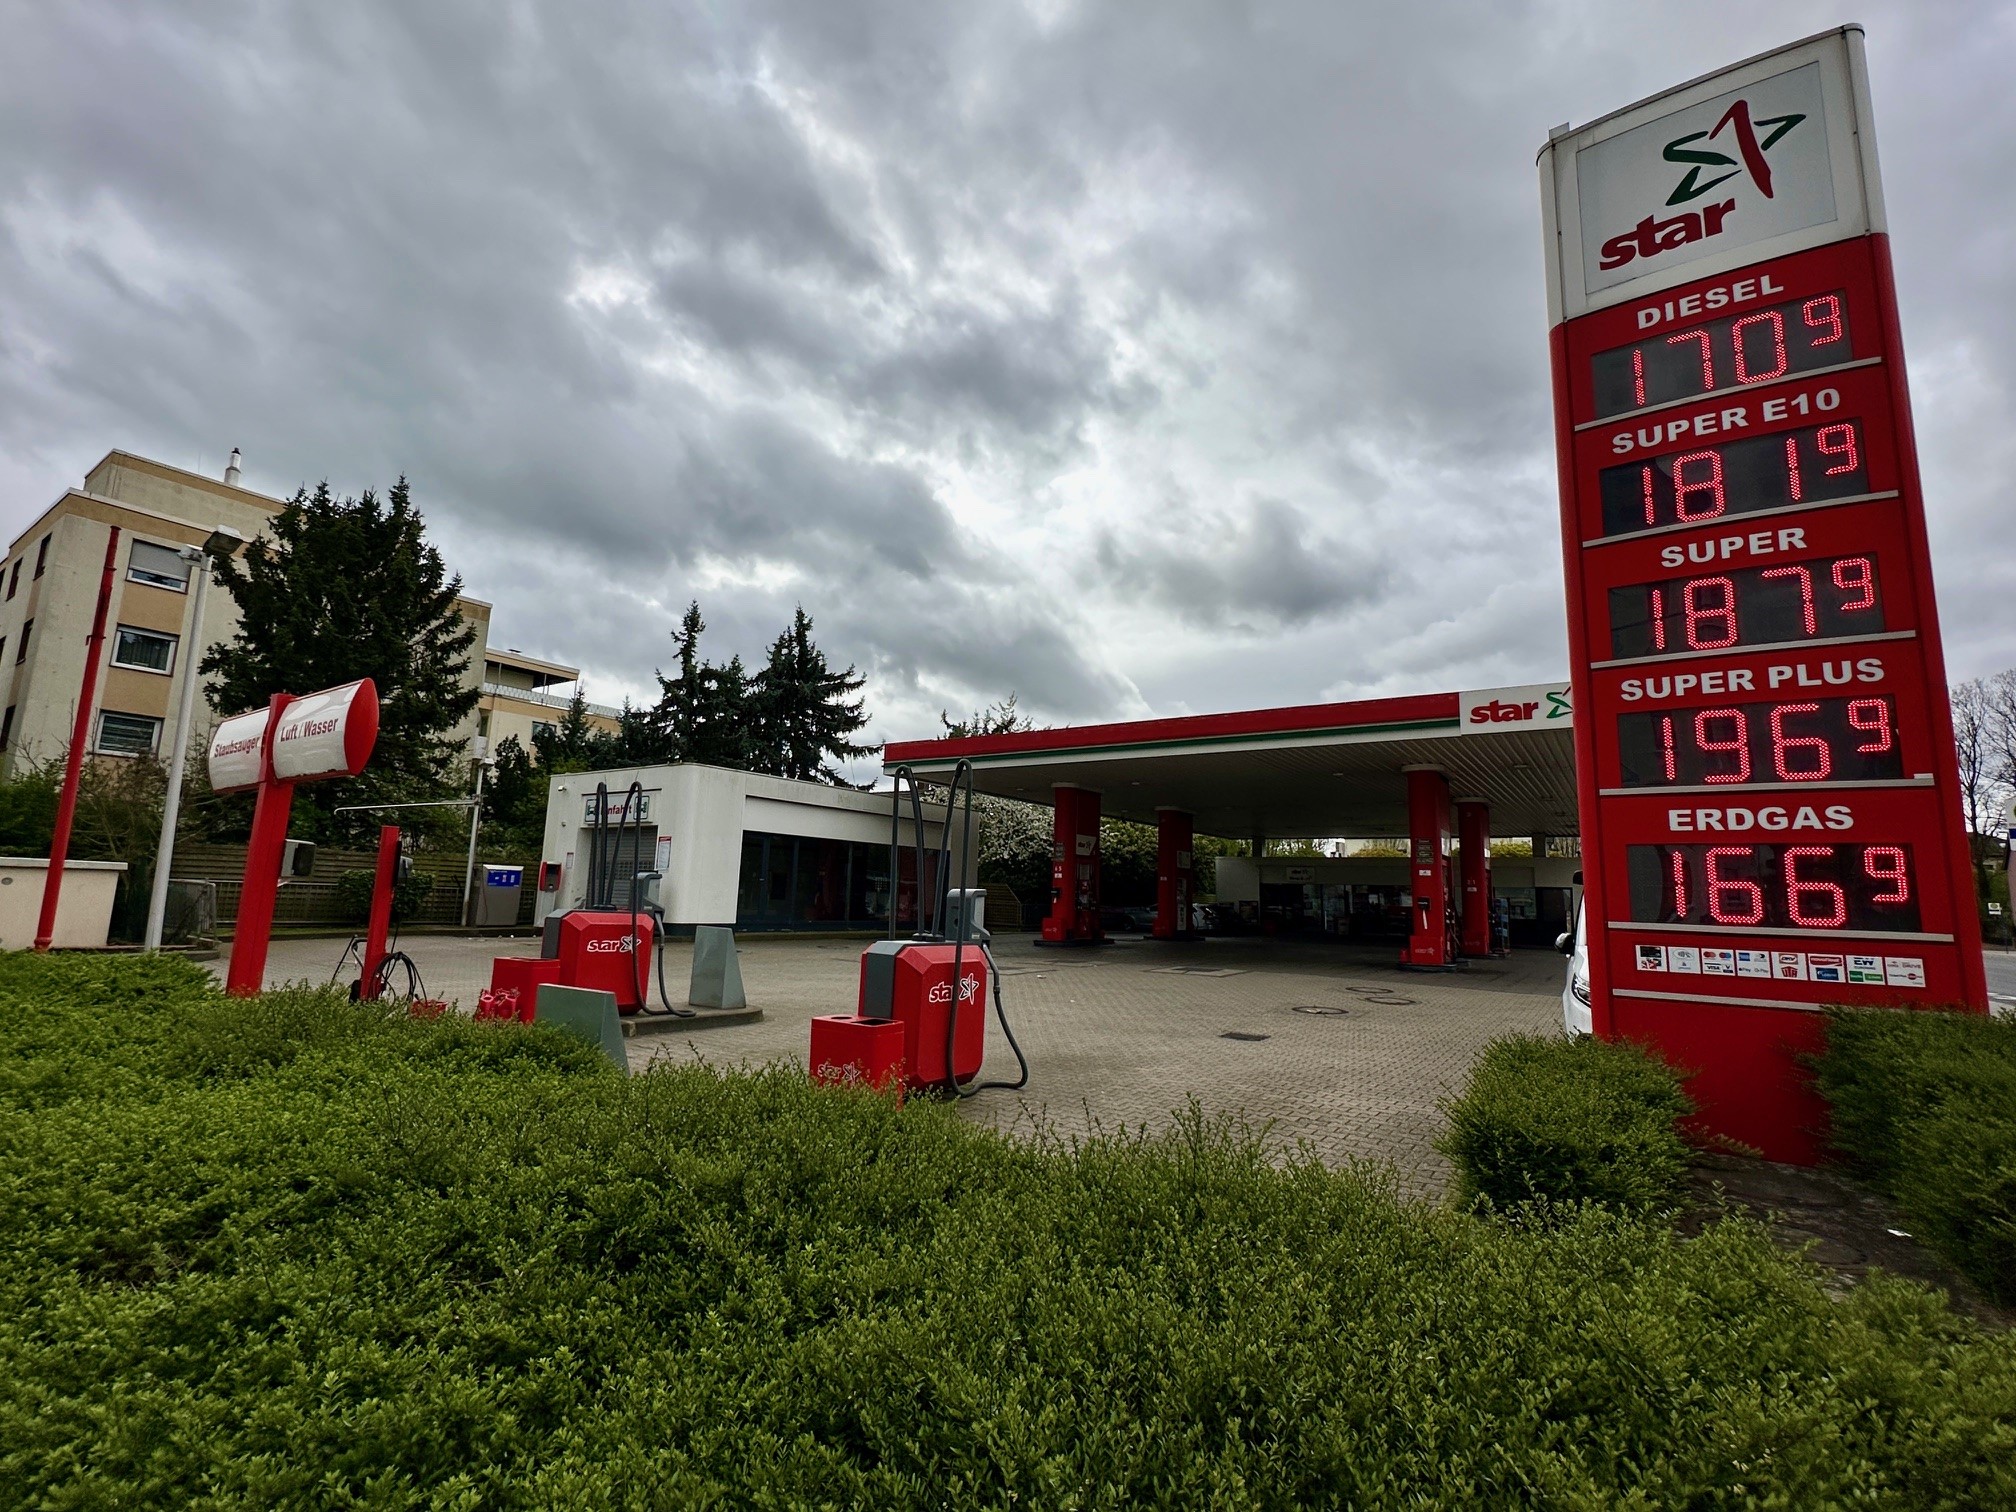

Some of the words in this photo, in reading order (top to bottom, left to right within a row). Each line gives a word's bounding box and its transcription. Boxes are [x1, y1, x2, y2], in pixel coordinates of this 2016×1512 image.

[1599, 197, 1736, 271] star
[1637, 275, 1784, 330] DIESEL
[1612, 406, 1750, 454] SUPER
[1762, 387, 1841, 423] E10
[1660, 527, 1808, 568] SUPER
[1620, 668, 1756, 702] SUPER
[1767, 657, 1886, 687] PLUS
[1469, 699, 1539, 724] star
[214, 736, 260, 758] Staubsauger
[280, 723, 299, 743] Luft
[304, 718, 339, 738] Wasser
[1668, 804, 1854, 832] ERDGAS
[928, 981, 954, 1003] sta
